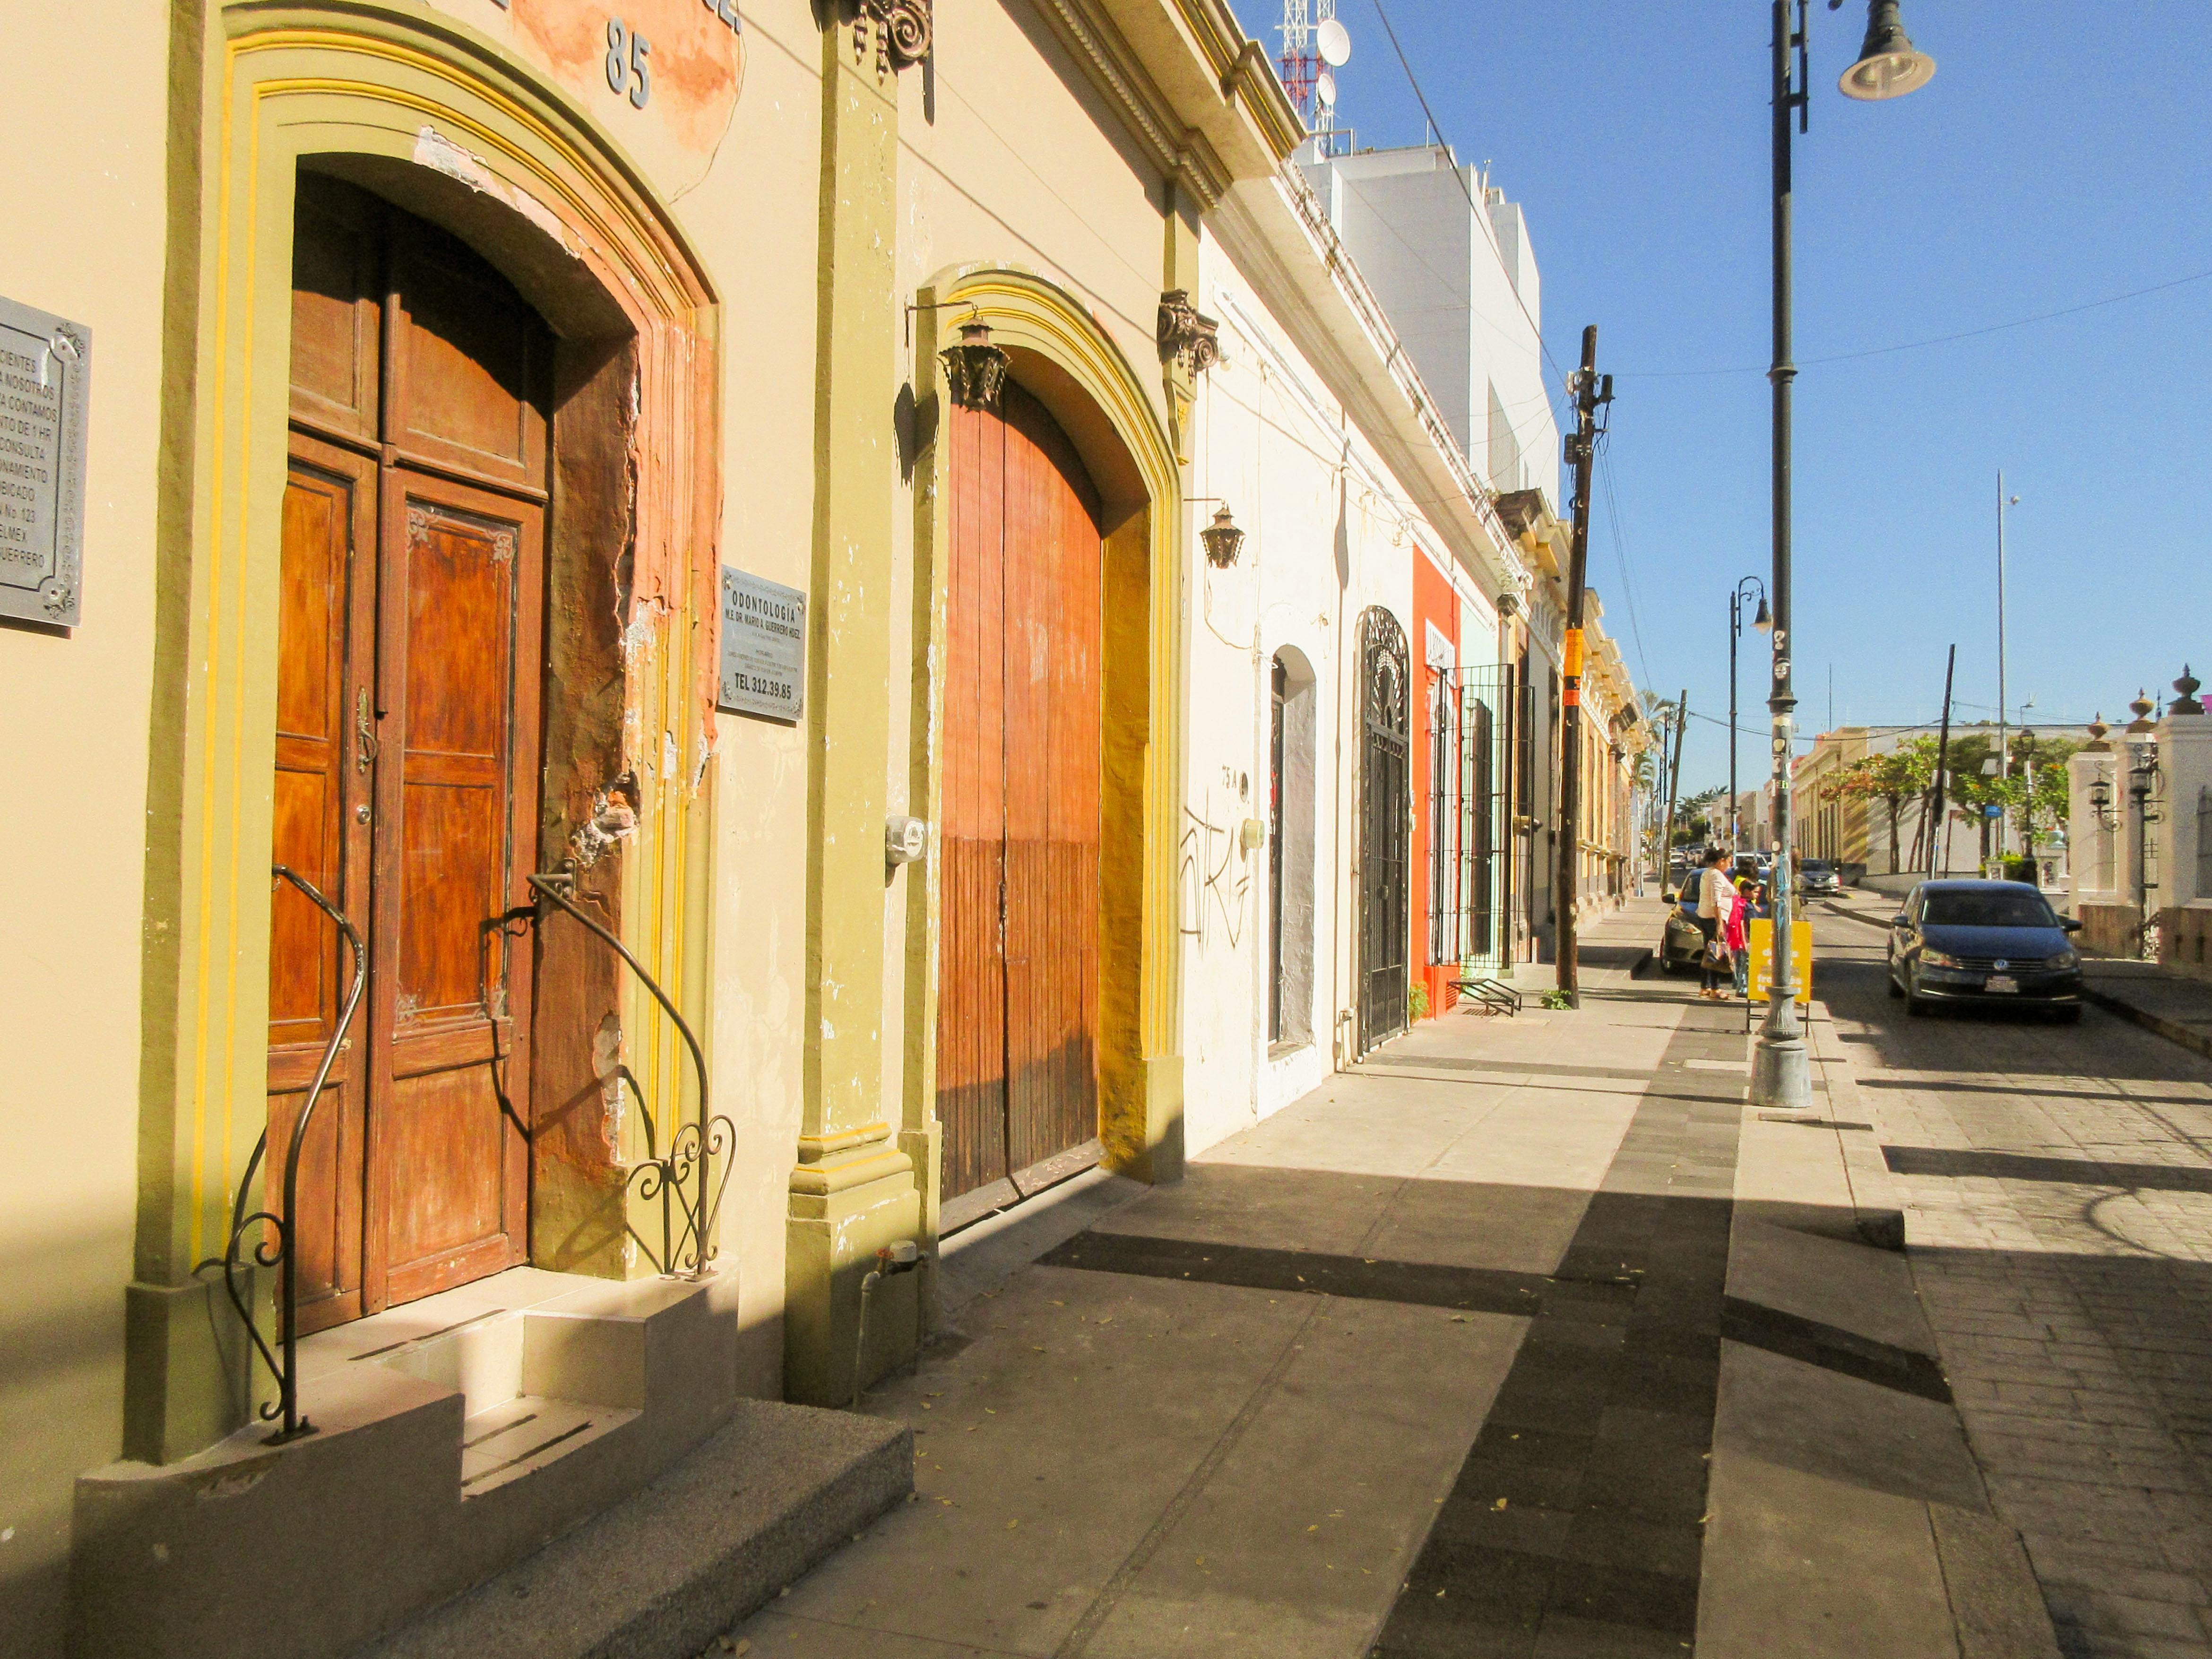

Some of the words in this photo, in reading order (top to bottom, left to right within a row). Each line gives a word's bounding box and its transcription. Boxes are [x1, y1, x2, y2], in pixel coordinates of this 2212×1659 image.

[606, 15, 650, 110] 85
[9, 395, 57, 422] CONTAMOS
[18, 420, 30, 436] DE
[0, 458, 48, 484] NAMIENTO
[0, 480, 35, 501] BICADO
[22, 508, 35, 523] 123
[0, 547, 45, 568] UERRERO
[732, 590, 795, 623] ODONTOLOGÍA
[744, 613, 759, 628] MARIO
[765, 620, 788, 636] GUERRERO
[752, 676, 791, 700] 312.39.85
